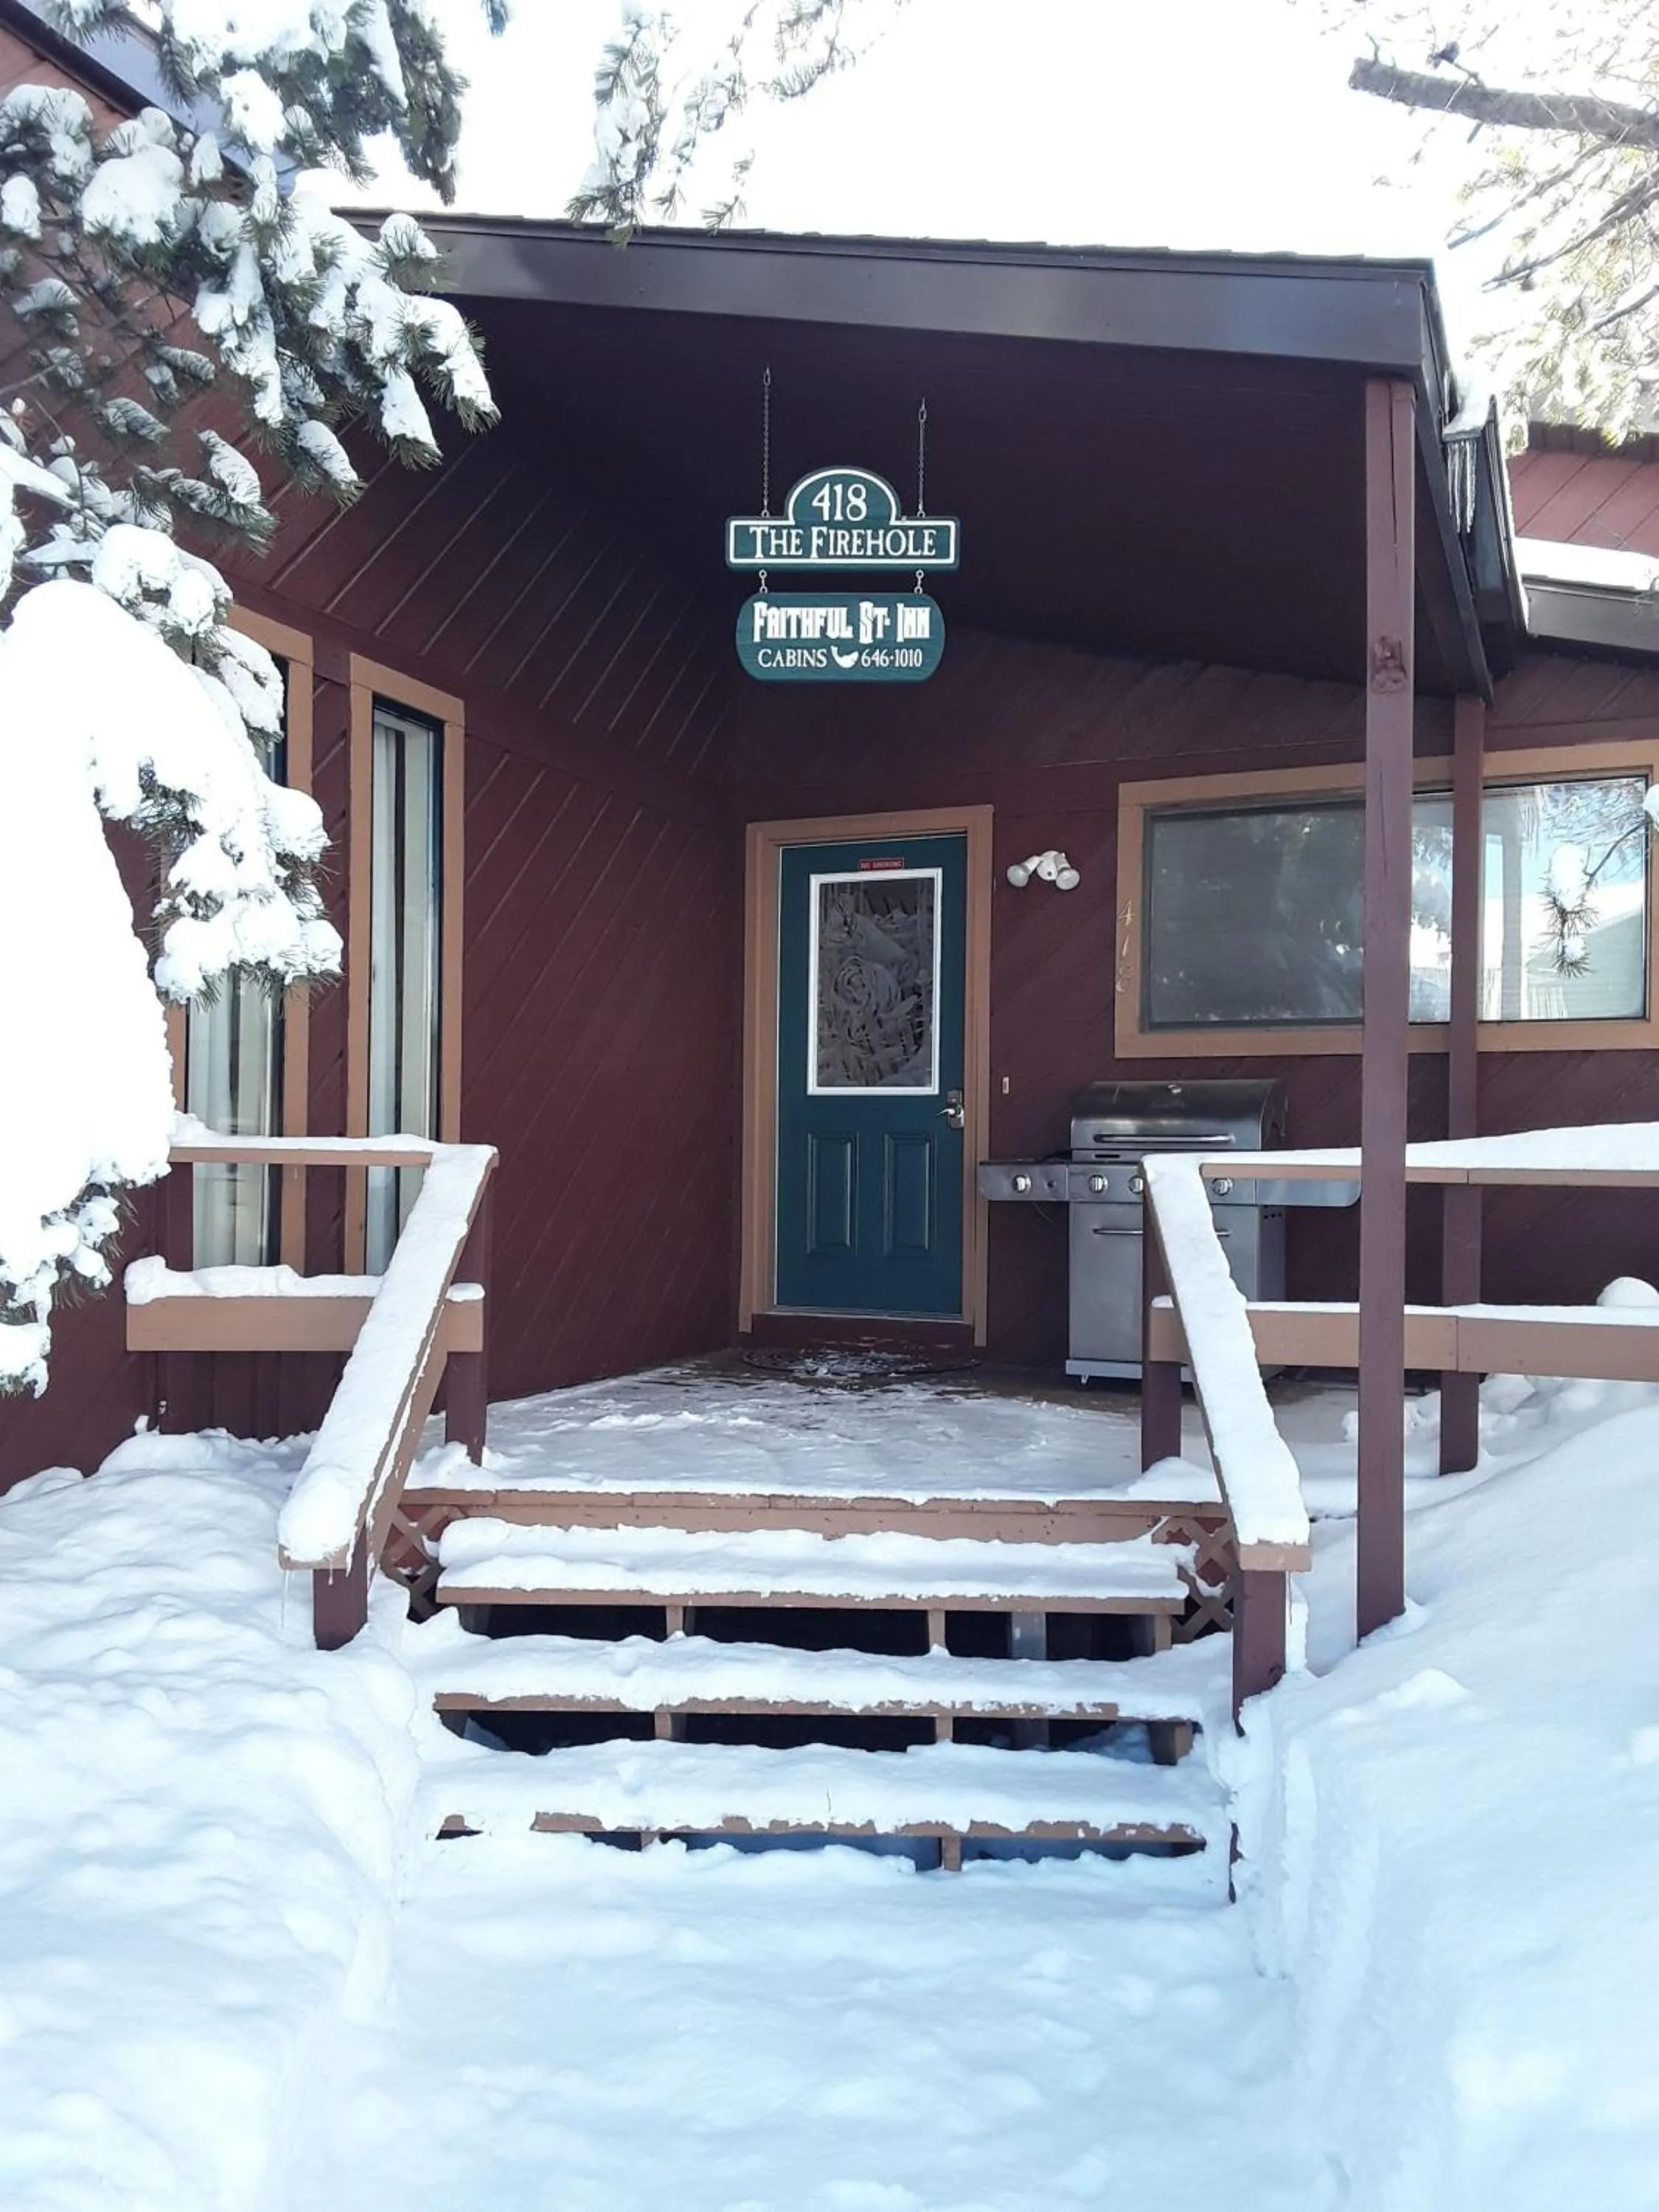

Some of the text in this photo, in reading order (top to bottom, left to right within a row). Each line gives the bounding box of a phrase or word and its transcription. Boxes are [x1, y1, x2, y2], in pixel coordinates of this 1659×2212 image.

[811, 483, 867, 521] 418
[749, 526, 937, 558] THE FIREHOLE
[753, 601, 854, 642] FAITHFUL
[896, 602, 931, 642] INN
[757, 648, 827, 667] CABINS
